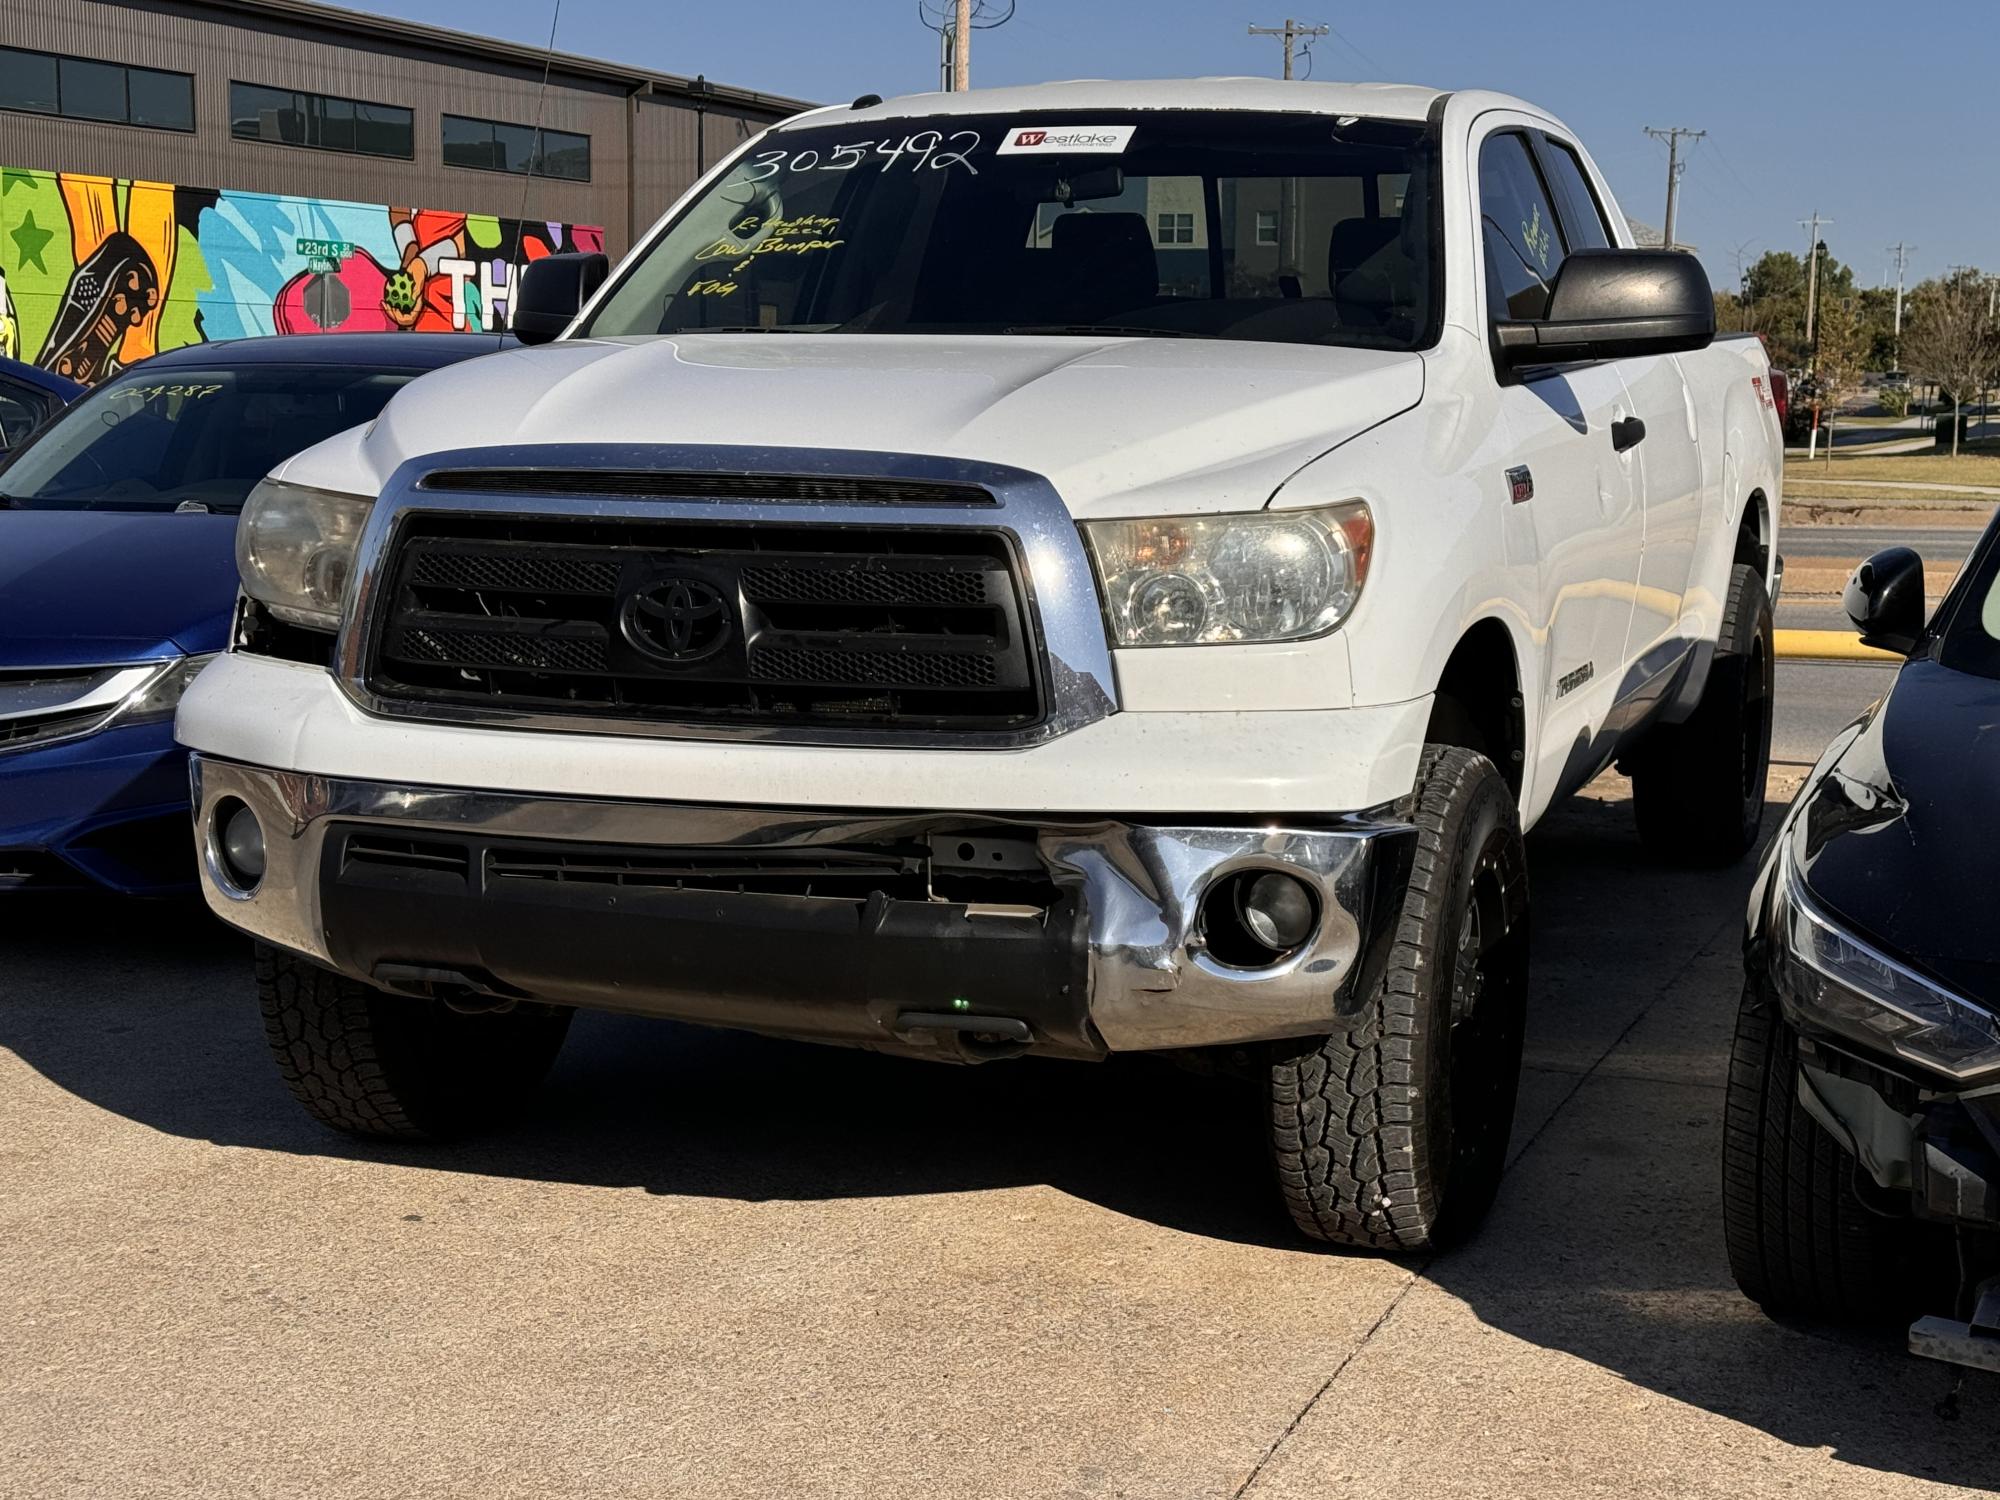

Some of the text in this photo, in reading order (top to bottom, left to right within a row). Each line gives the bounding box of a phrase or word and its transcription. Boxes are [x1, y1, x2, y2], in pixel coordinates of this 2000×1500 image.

[1018, 133, 1117, 145] Westlake
[727, 131, 981, 188] 305492
[305, 242, 328, 256] 23rd
[752, 237, 845, 255] Bumper
[439, 258, 529, 330] TH
